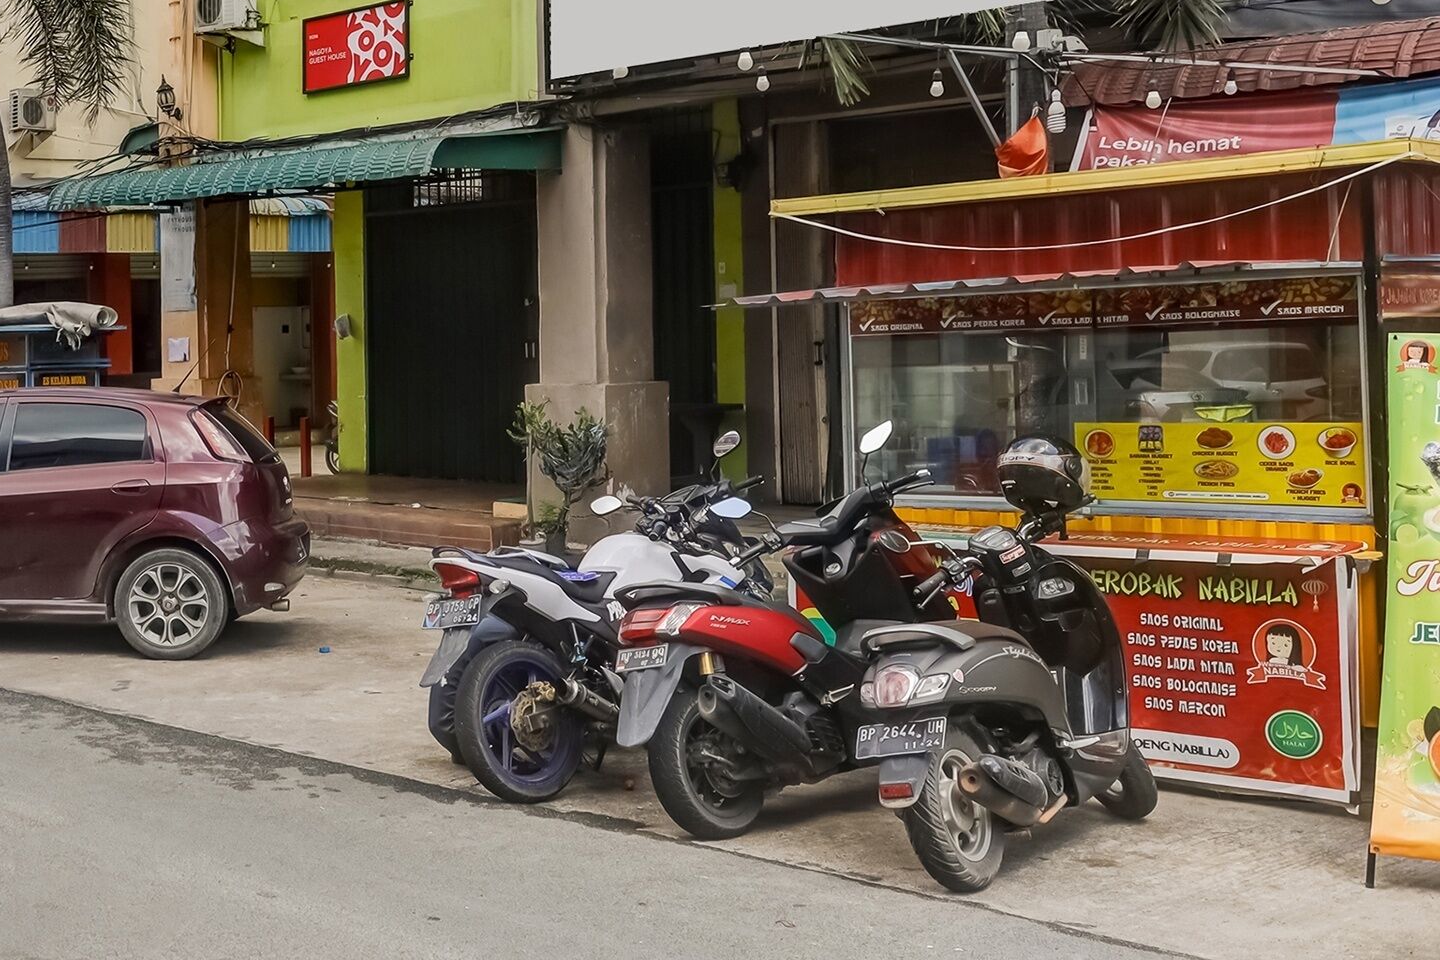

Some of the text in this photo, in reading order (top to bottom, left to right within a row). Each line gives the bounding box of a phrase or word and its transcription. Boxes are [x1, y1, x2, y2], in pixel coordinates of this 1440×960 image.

[309, 47, 332, 57] NAGOYA
[309, 52, 346, 64] GUEST HOUSE
[1099, 136, 1241, 154] Lebih hemat
[1160, 310, 1241, 320] SAOS BOLOGNAISE
[1277, 305, 1344, 315] SAOS MERCON
[871, 324, 889, 332] SAOS
[1000, 319, 1026, 327] KOREA
[43, 376, 50, 386] ES
[50, 376, 70, 385] KELAPA
[1089, 569, 1299, 607] EROBAK NABILLA
[427, 603, 440, 615] BP
[710, 614, 751, 626] NMAX
[1140, 613, 1224, 631] SAOS ORIGINAL
[1127, 632, 1239, 654] SAOS PEDAS KOREA
[1133, 653, 1235, 675] SAOS LADA HITAM
[1263, 667, 1307, 679] NABILLA
[1133, 674, 1237, 696] SAOS BOLOGNAISE
[1145, 696, 1226, 717] SAOS MERCON
[861, 729, 876, 742] BP
[928, 720, 943, 734] UH
[1275, 721, 1314, 739] حلال
